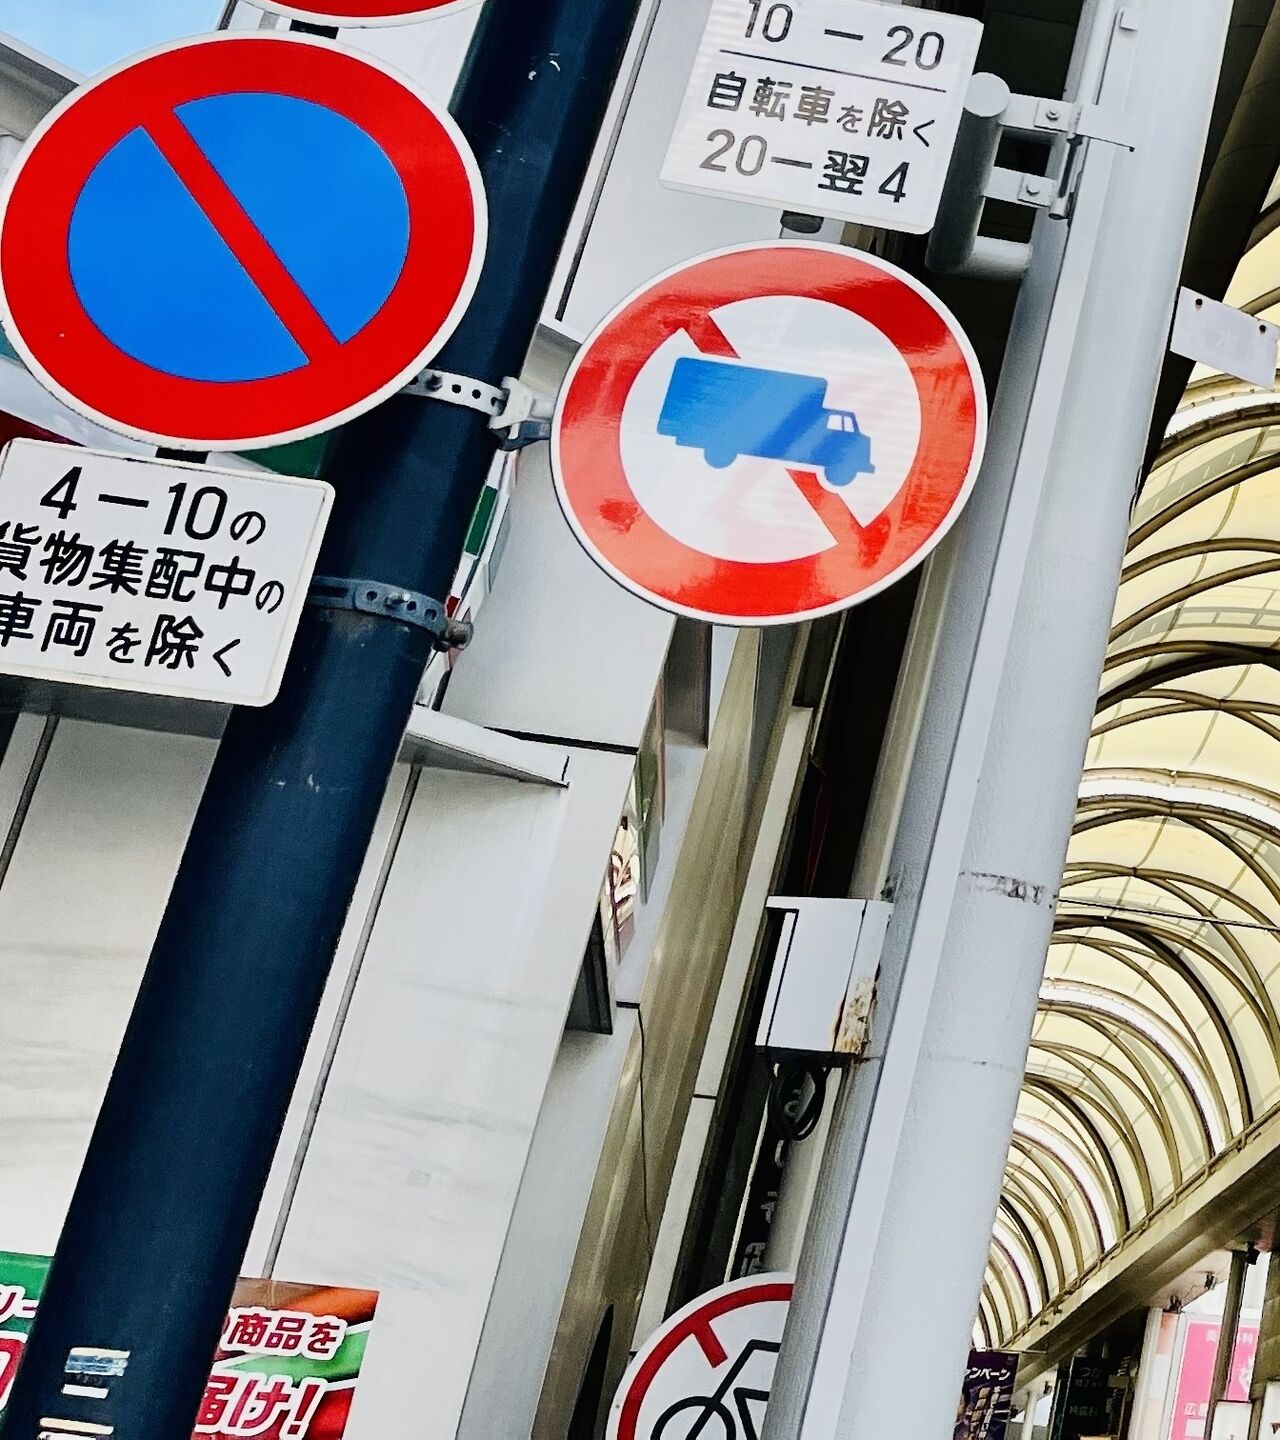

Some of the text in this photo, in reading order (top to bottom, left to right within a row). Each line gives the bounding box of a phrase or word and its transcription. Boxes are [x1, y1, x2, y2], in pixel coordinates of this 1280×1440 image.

[880, 25, 945, 71] 20
[706, 70, 936, 148] 自転車を除く
[0, 520, 285, 614] 貨物集配中の
[0, 591, 241, 677] 車両を除く
